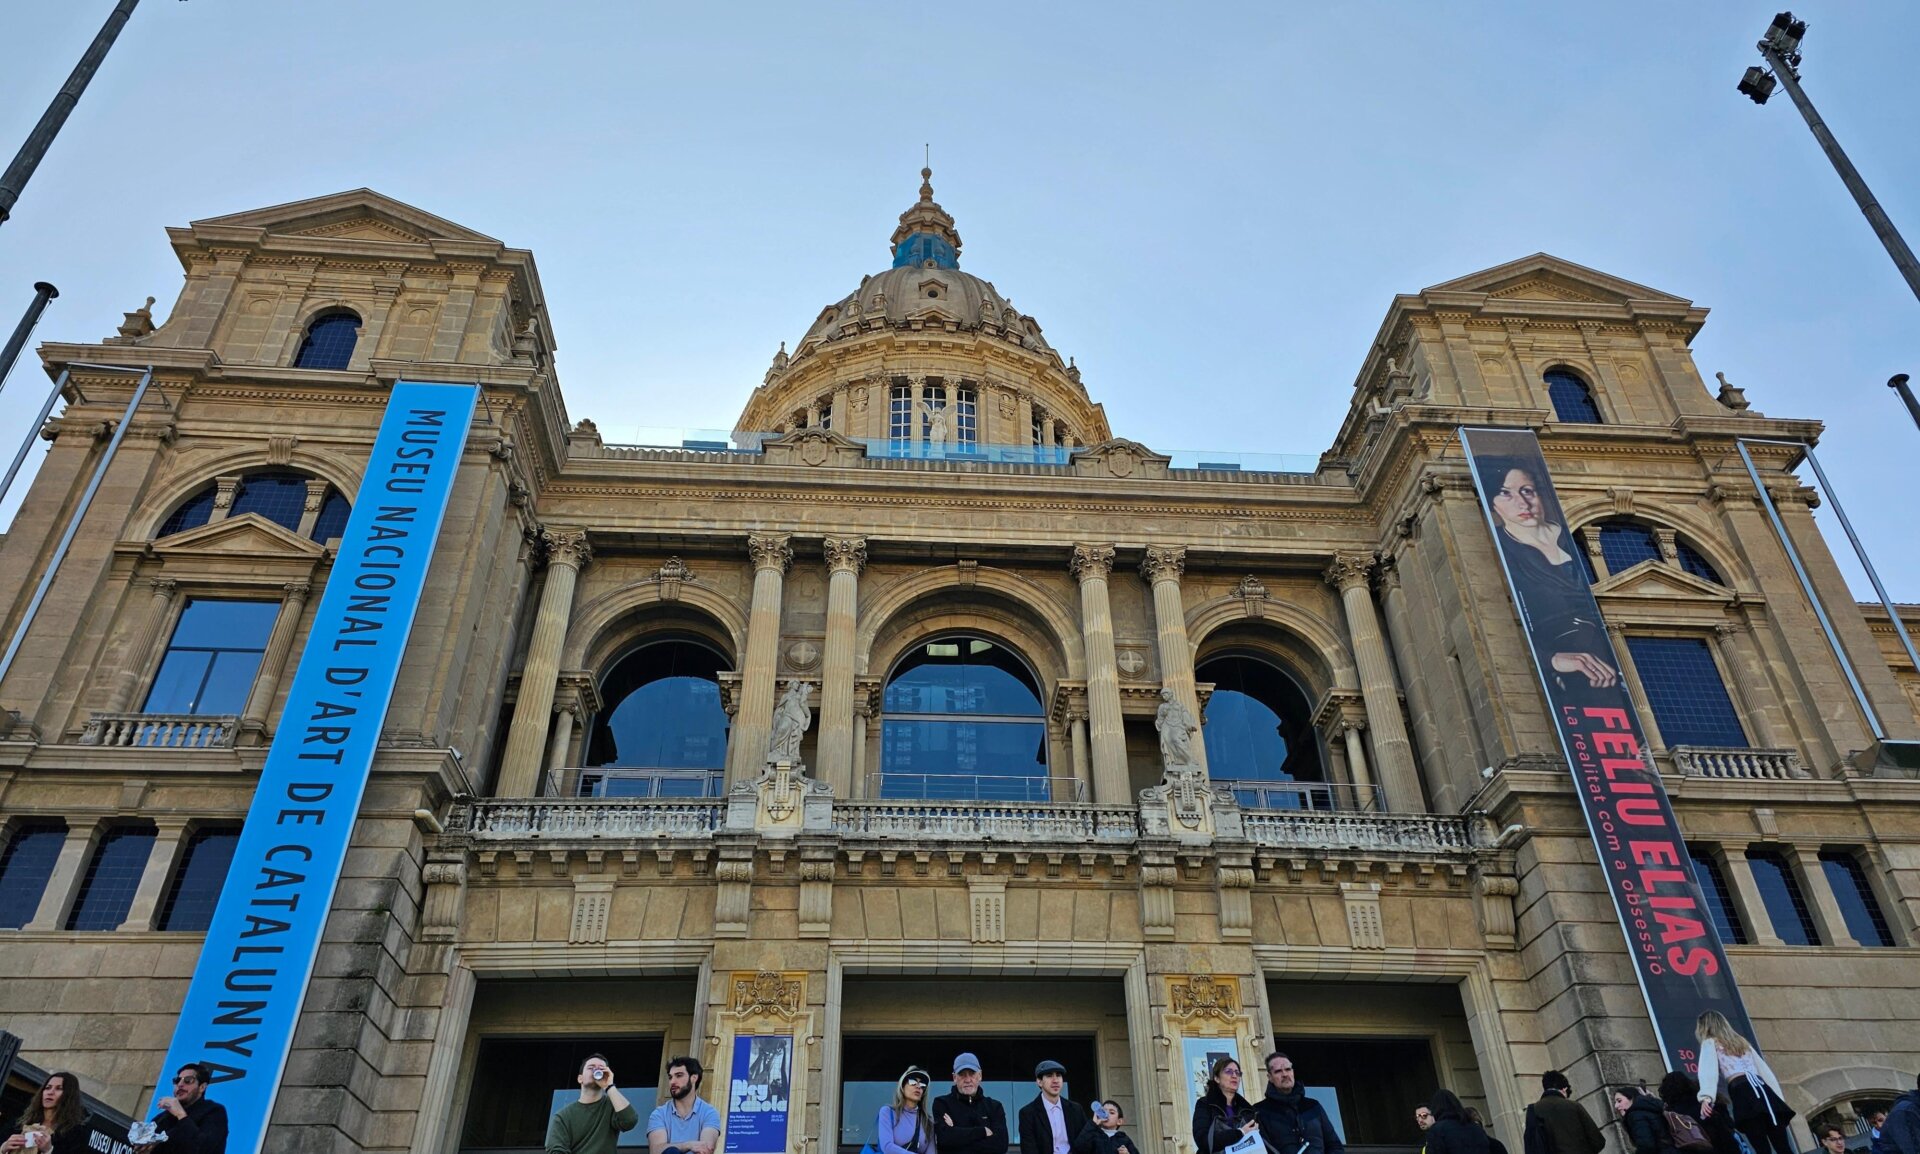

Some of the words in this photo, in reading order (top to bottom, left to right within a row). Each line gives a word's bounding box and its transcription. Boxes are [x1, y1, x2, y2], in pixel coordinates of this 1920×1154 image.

[386, 410, 446, 493] MUSEU
[334, 506, 417, 652] NACIONAL
[298, 667, 369, 765] D'ART
[276, 783, 334, 825] DE
[1563, 706, 1578, 725] La
[1572, 733, 1606, 802] realitat
[1598, 810, 1621, 851] com
[1614, 860, 1627, 870] a
[1621, 878, 1666, 975] obsessió
[1583, 707, 1665, 827] FELIU
[1629, 840, 1719, 977] ELIAS
[199, 844, 313, 1085] CATALUNYA
[1678, 1049, 1695, 1060] 30
[88, 1129, 112, 1154] MUSEU
